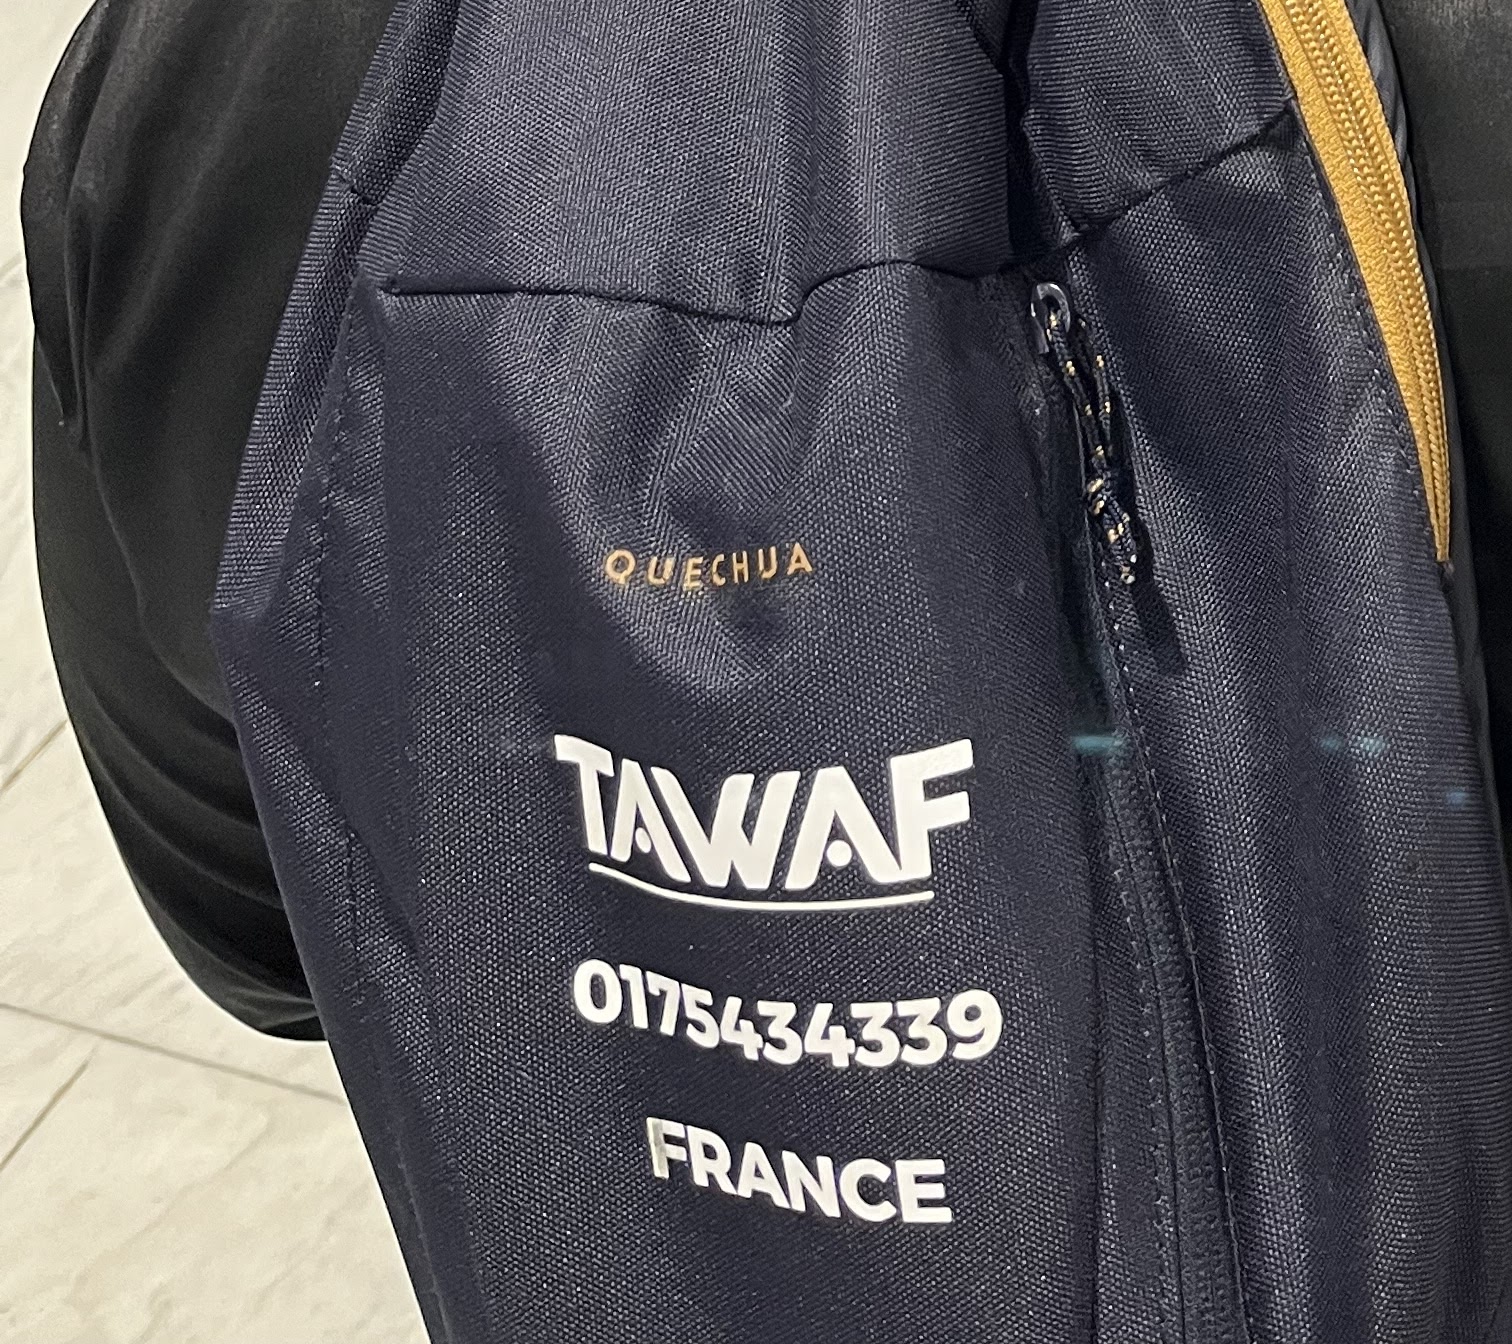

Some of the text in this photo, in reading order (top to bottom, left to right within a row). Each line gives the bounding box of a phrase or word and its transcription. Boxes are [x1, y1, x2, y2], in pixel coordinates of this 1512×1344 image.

[604, 542, 814, 591] QUECHUA
[554, 734, 973, 891] TAWAF
[573, 959, 1003, 1068] 0175434339
[646, 1116, 953, 1224] FRANCE
